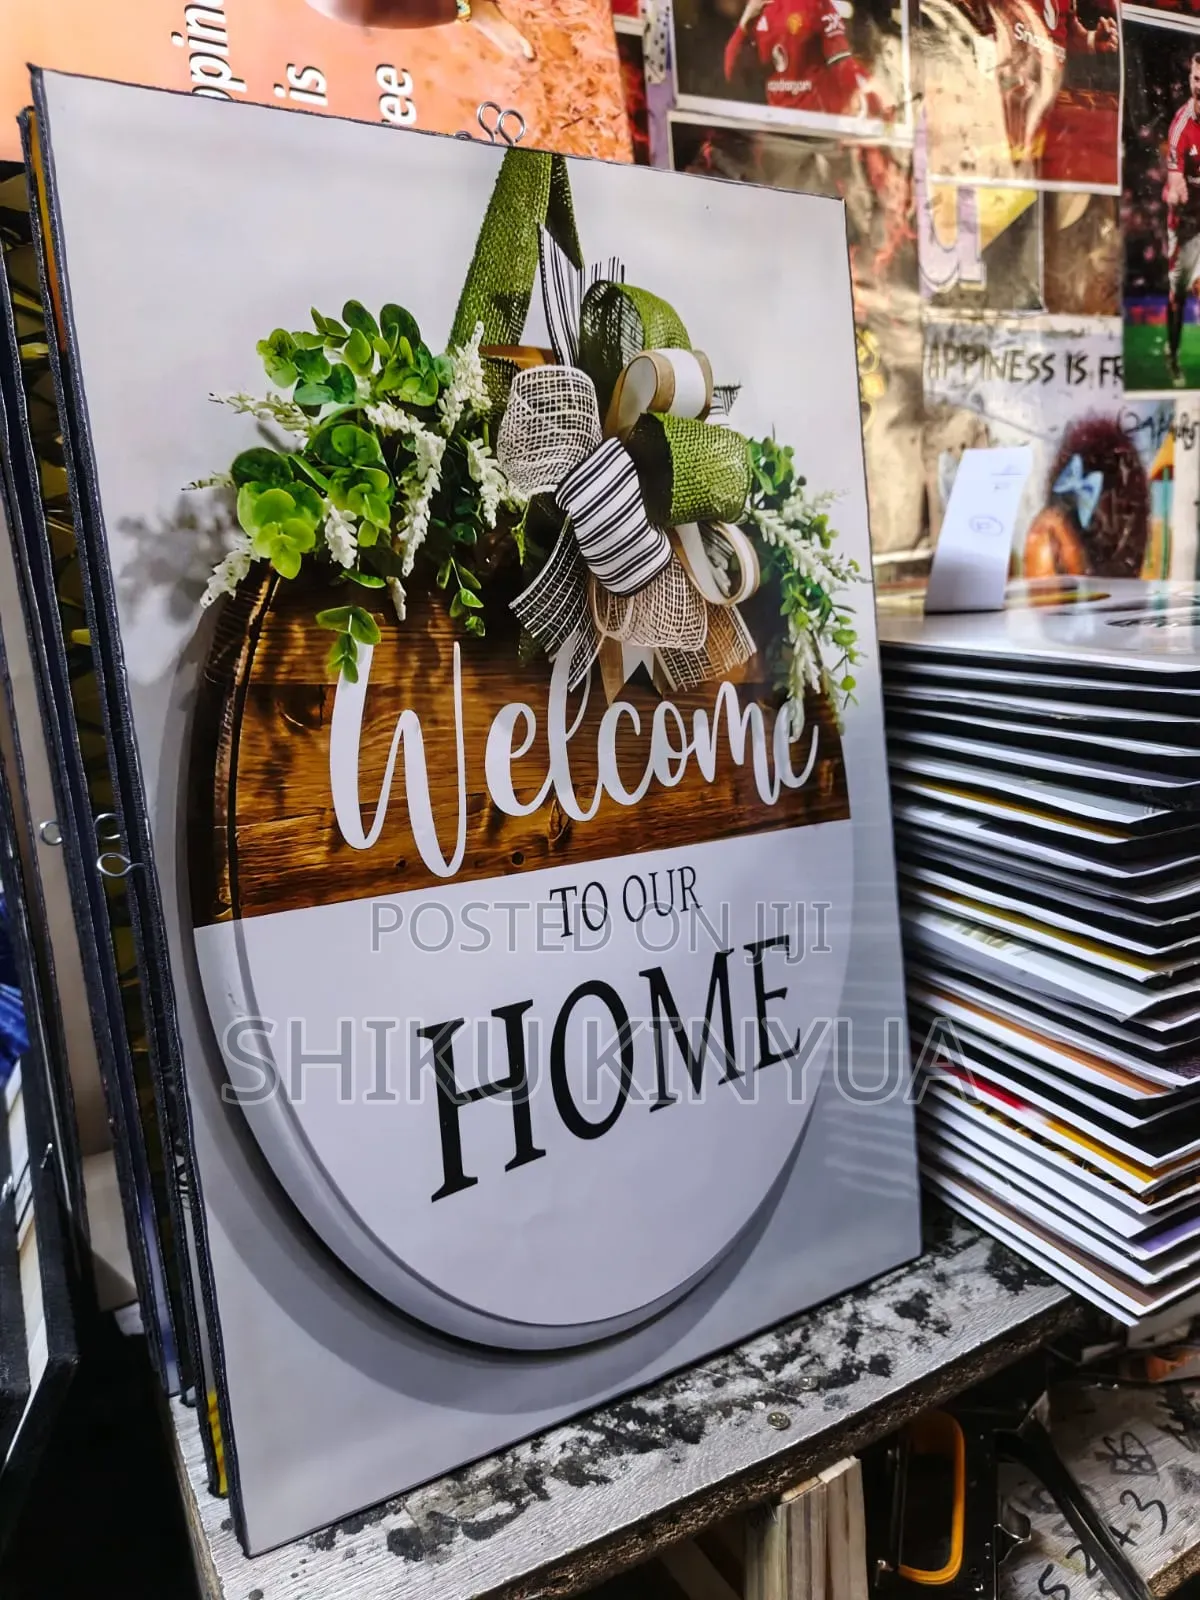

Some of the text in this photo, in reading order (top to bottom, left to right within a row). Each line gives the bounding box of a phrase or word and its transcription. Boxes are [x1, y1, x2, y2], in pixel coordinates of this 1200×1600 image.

[171, 0, 247, 100] pin
[273, 63, 328, 107] is
[1064, 352, 1089, 385] IS
[329, 630, 820, 879] Welcome
[549, 866, 704, 938] TO OUR
[416, 934, 803, 1204] HOME
